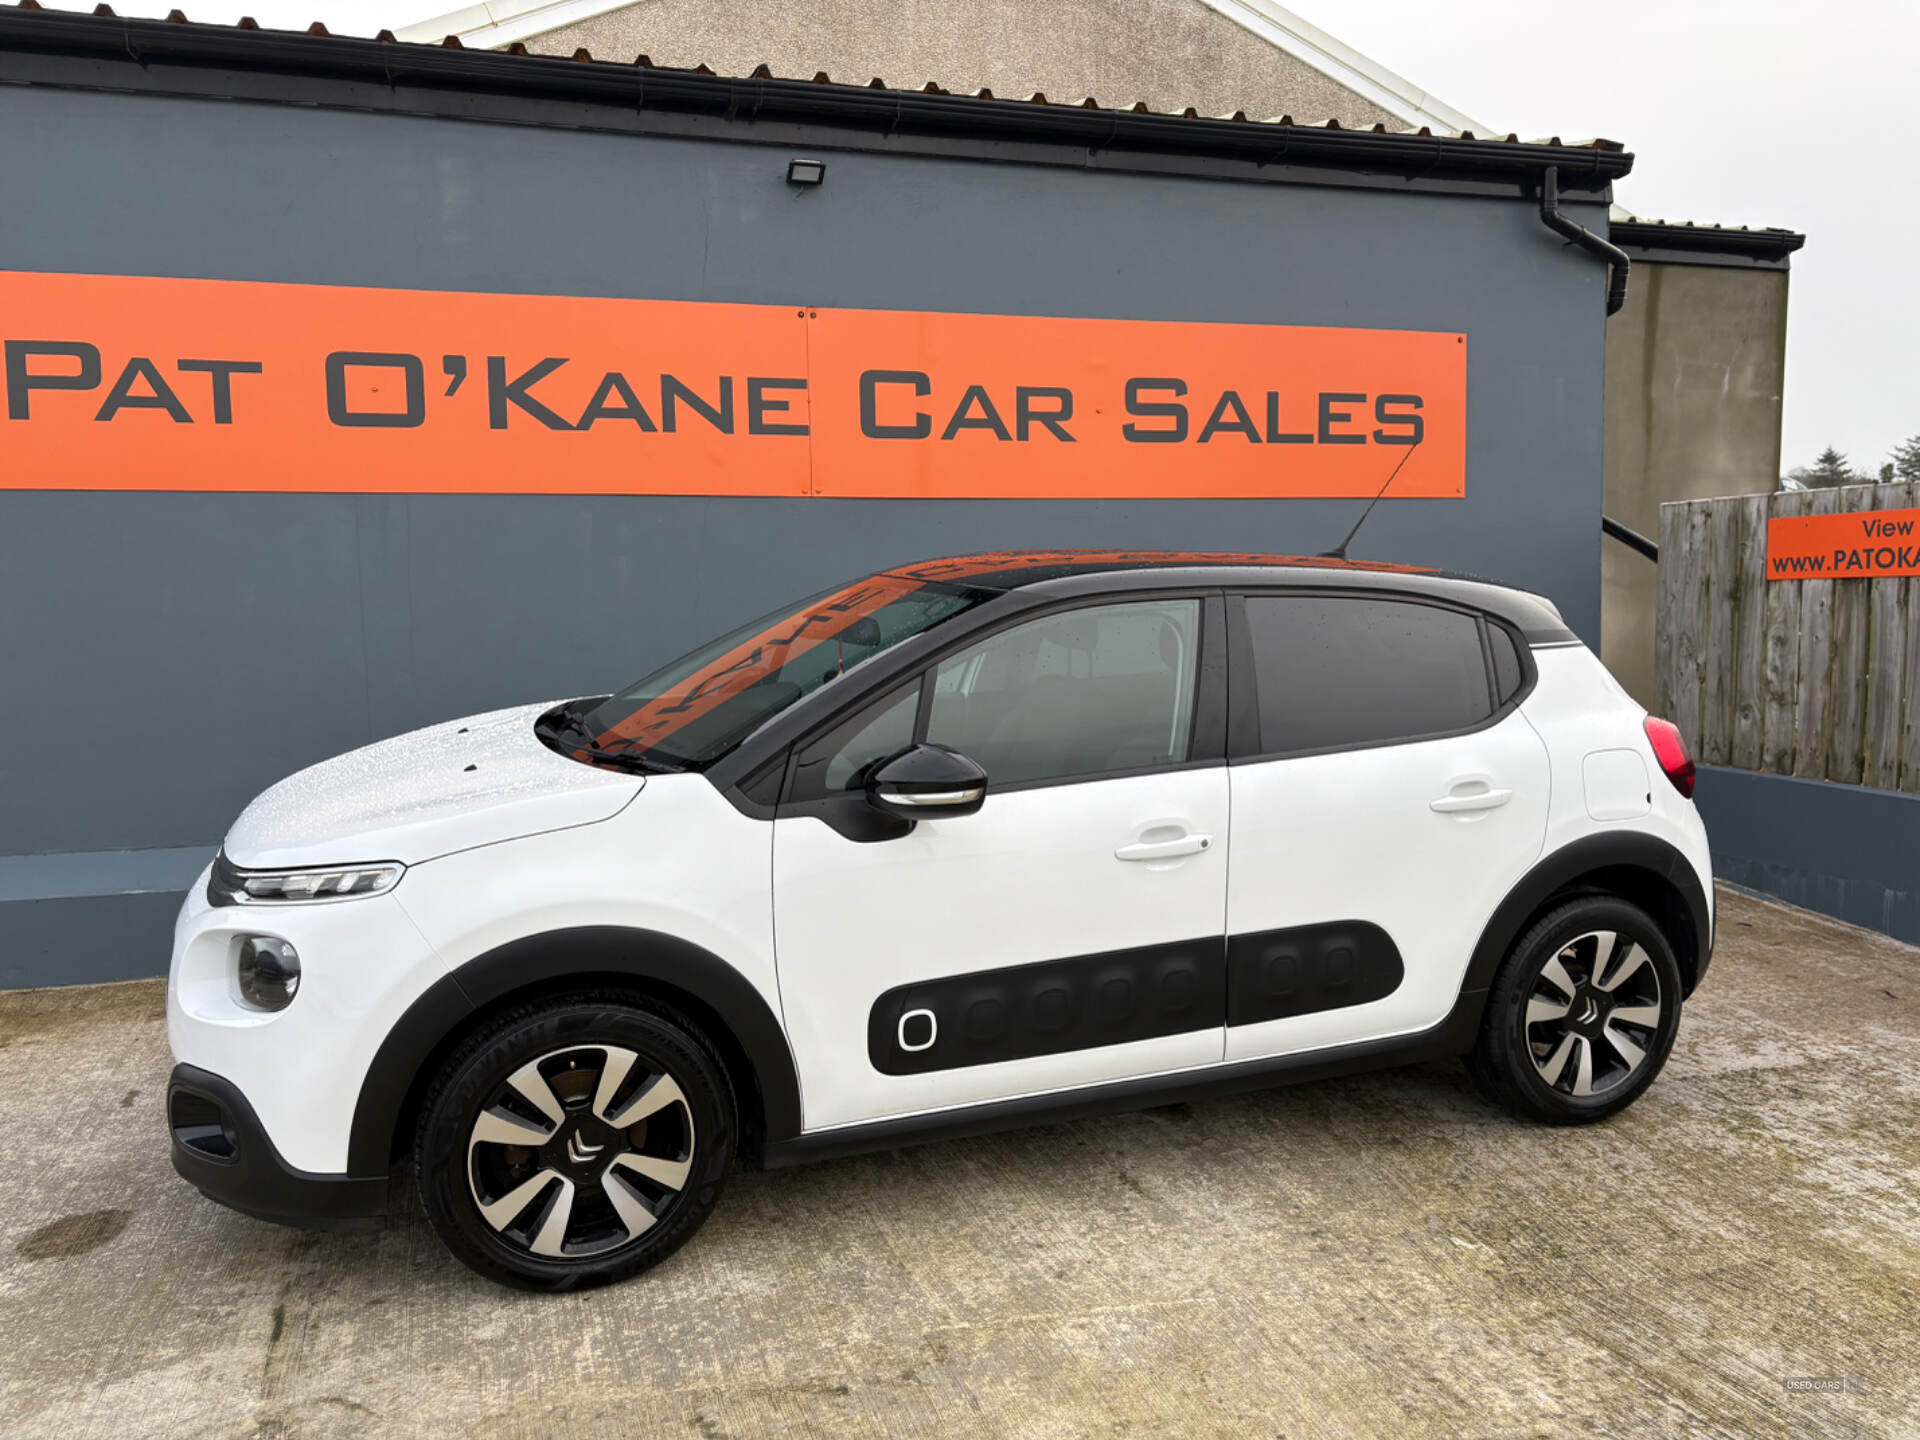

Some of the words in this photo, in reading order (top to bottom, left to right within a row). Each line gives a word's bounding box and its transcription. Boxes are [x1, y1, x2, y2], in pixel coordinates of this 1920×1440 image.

[5, 339, 263, 425] PAT
[325, 351, 811, 437] O'KANE
[859, 369, 1078, 443] CAR
[1122, 377, 1425, 446] SALES
[1862, 519, 1915, 538] View
